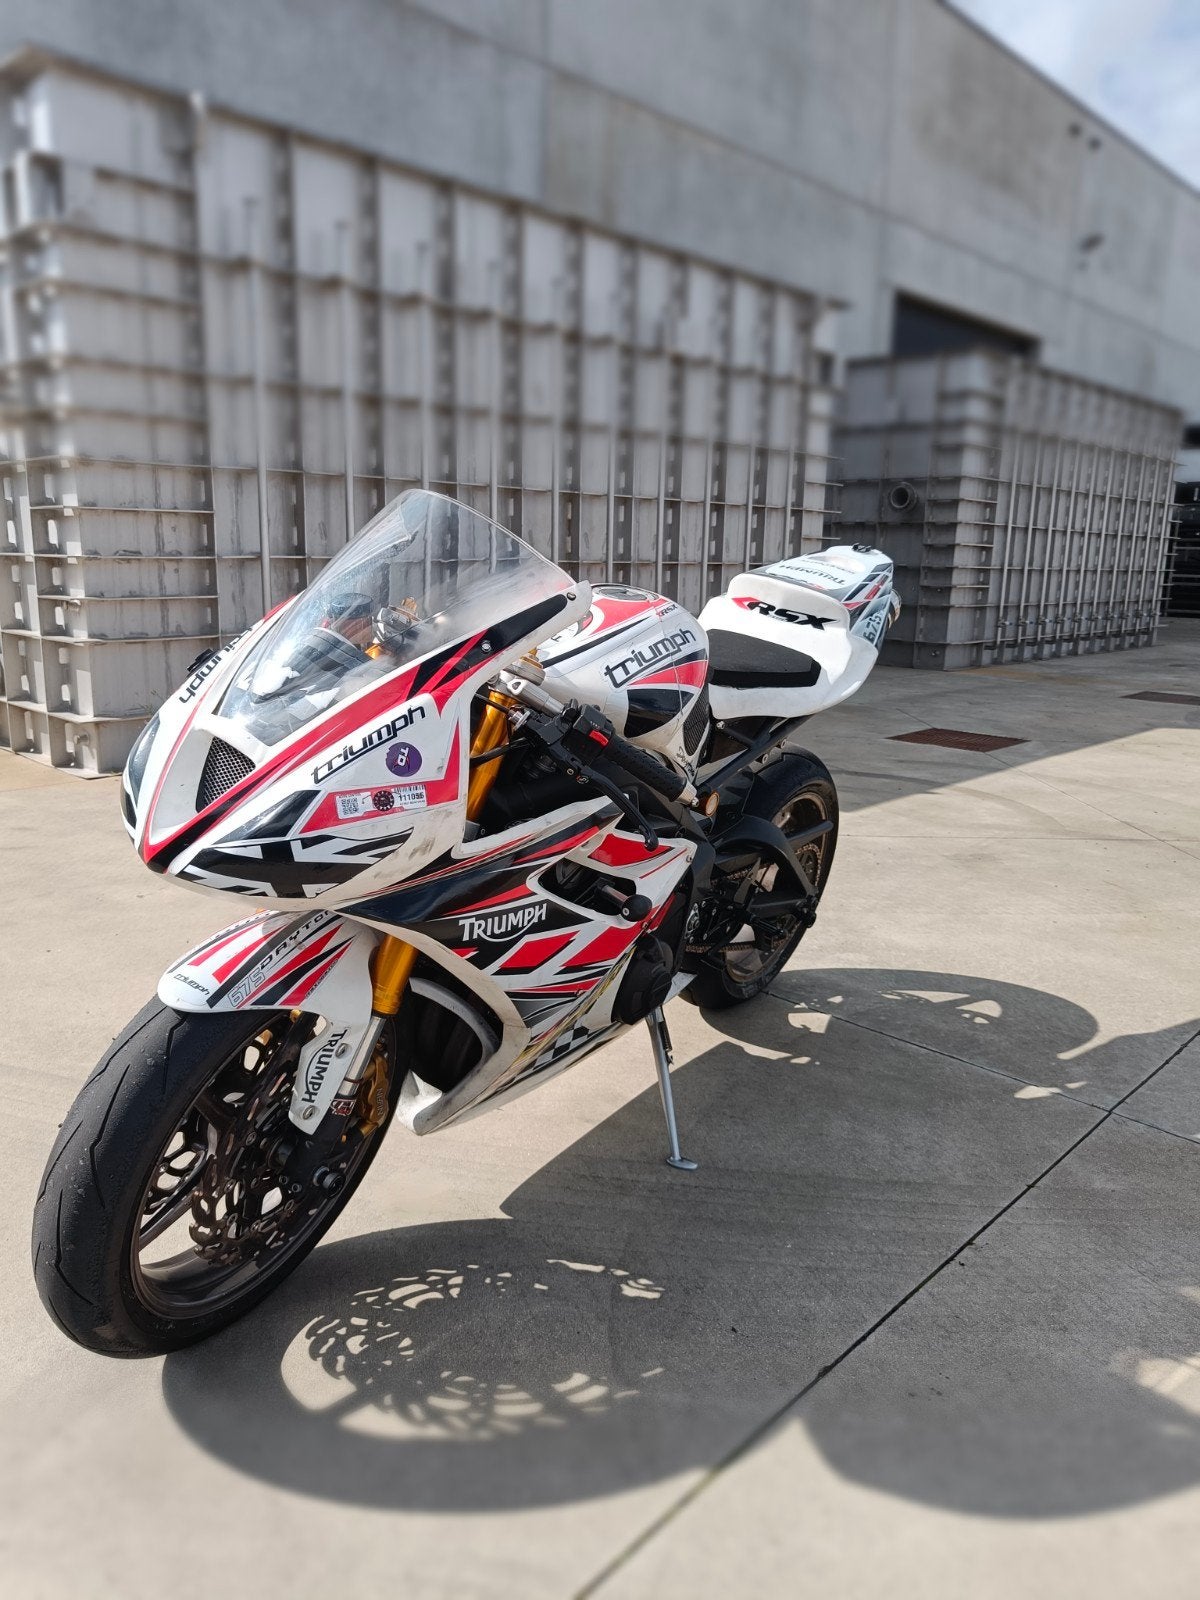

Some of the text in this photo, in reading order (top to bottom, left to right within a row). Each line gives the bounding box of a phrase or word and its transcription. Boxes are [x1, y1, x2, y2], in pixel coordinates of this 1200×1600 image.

[747, 600, 838, 631] RSX
[604, 628, 696, 689] triumph
[311, 705, 426, 784] triumph
[458, 903, 548, 942] TRIUMPH
[228, 966, 266, 1007] 675
[301, 1028, 348, 1103] TRIUMPH
